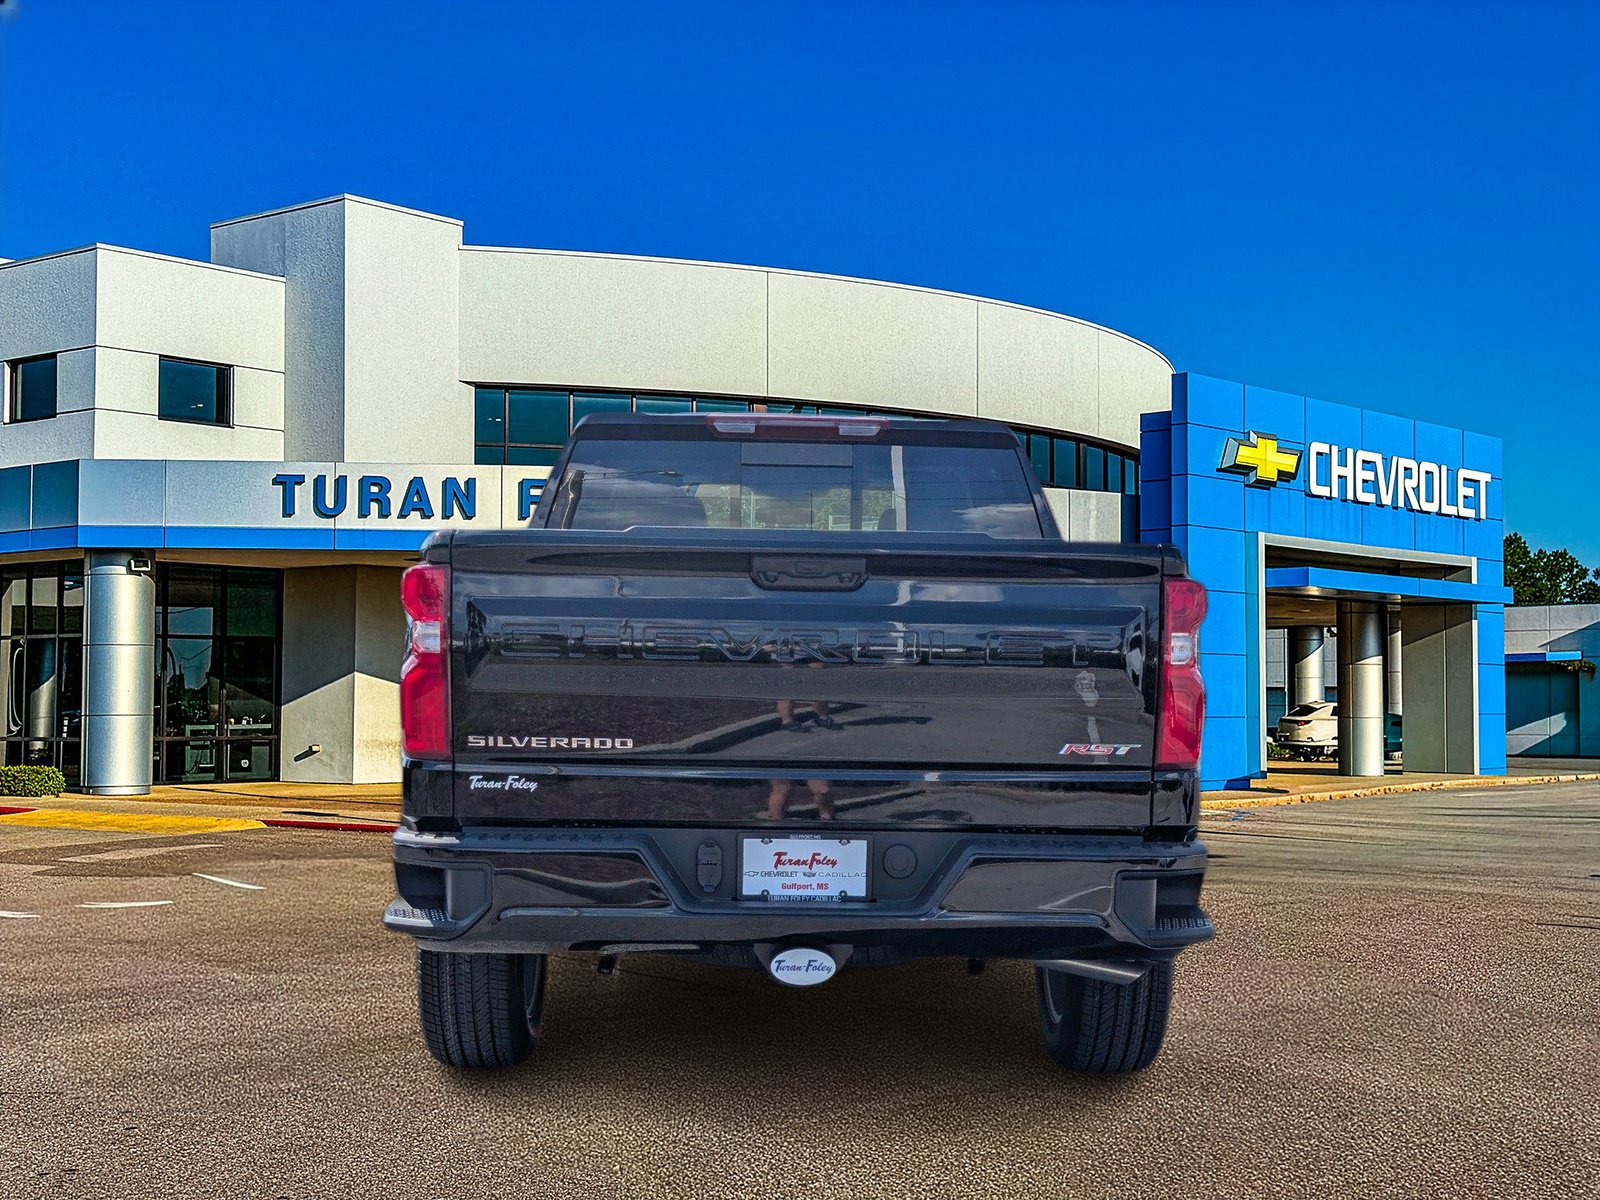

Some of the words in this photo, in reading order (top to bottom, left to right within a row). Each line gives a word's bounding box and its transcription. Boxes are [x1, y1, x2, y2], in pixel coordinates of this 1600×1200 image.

[1308, 441, 1491, 520] CHEVROLET
[272, 474, 477, 520] TURAN
[500, 622, 1121, 666] CHEVROLET
[467, 735, 633, 749] SILVERADO
[1058, 743, 1141, 755] RST
[469, 775, 538, 792] Turan-Foley
[781, 883, 815, 891] Gulfport,
[816, 883, 829, 891] MS
[775, 959, 833, 974] Turan-Foley
